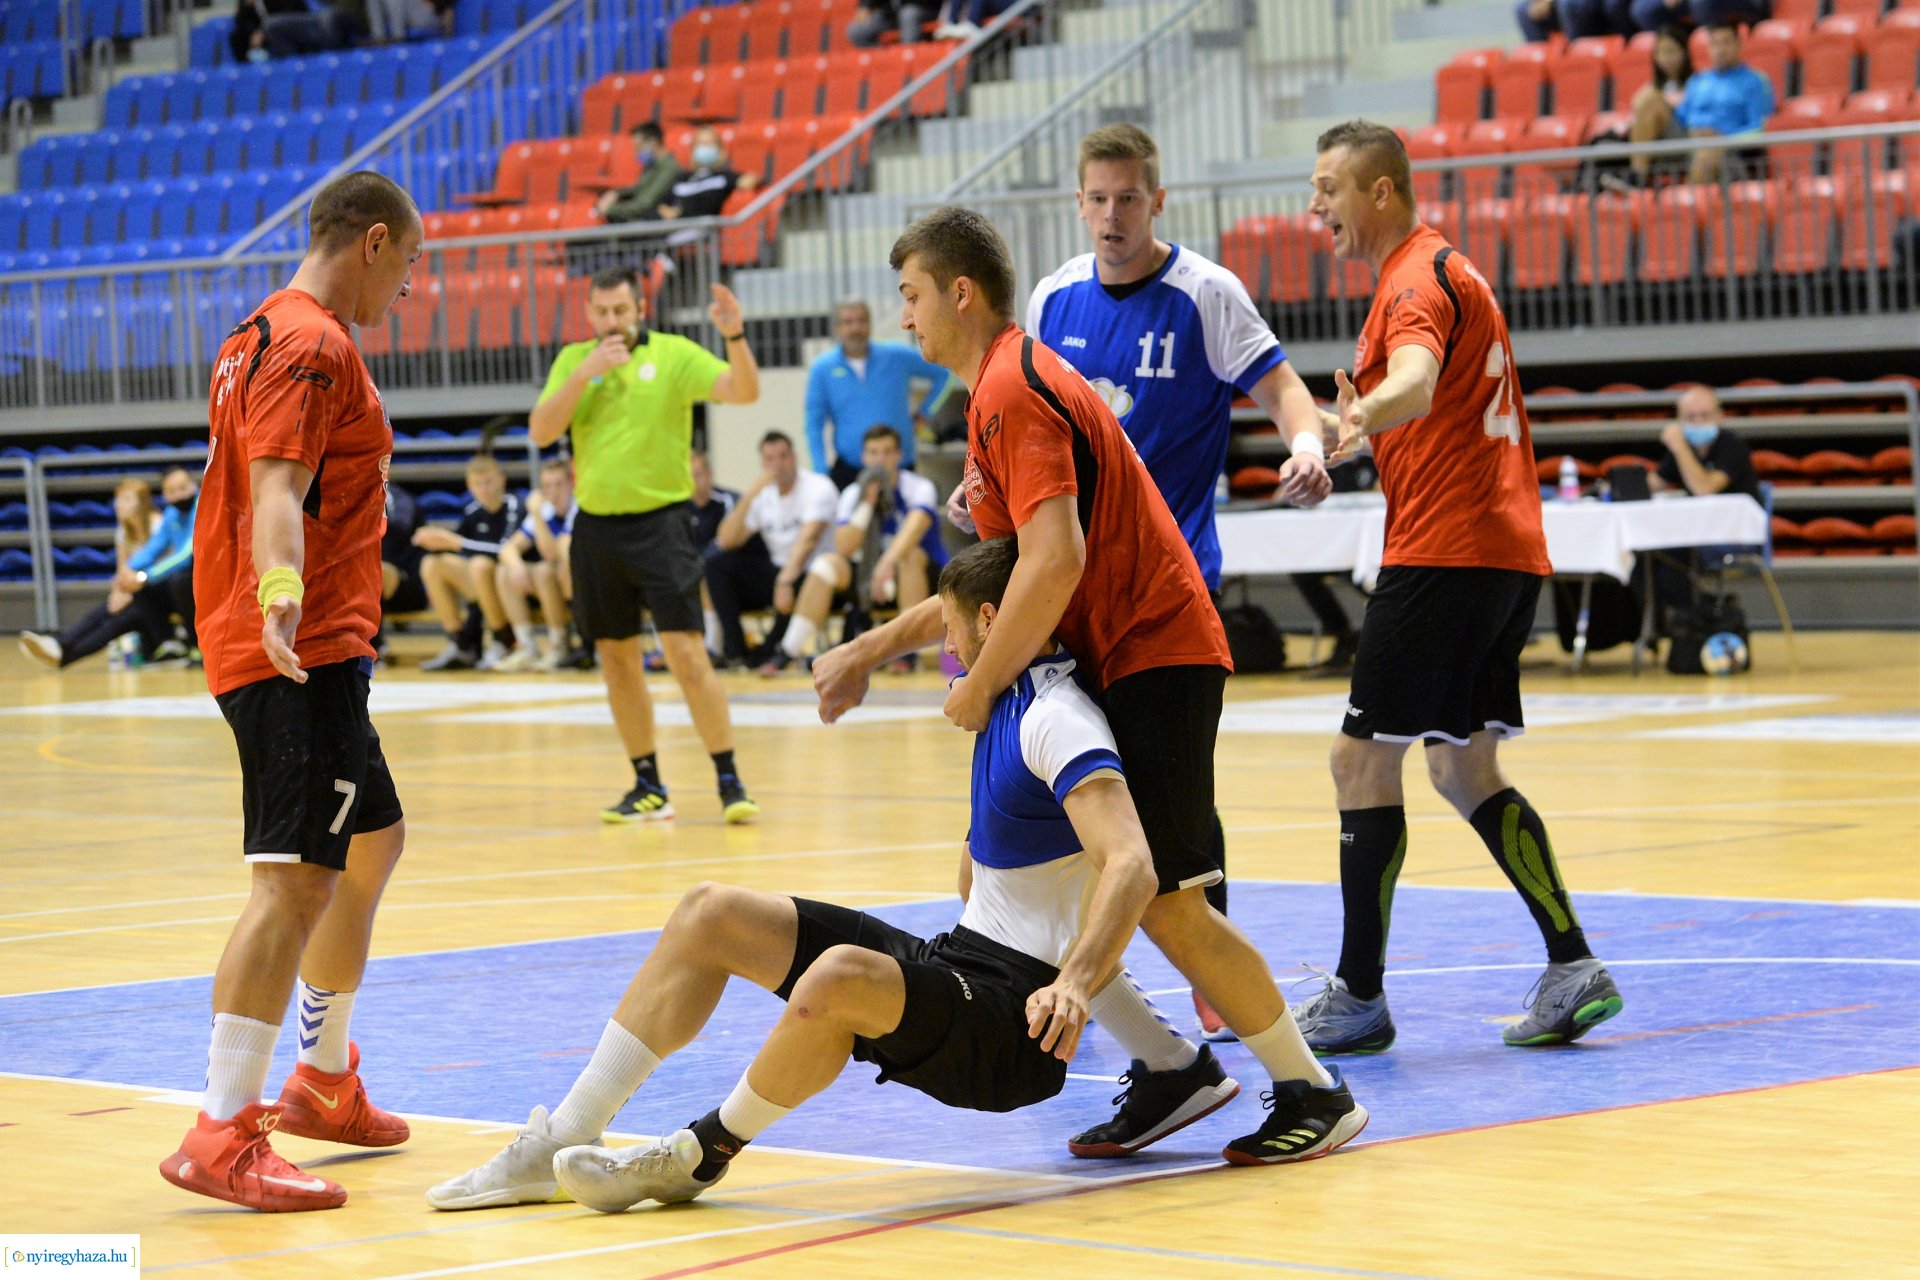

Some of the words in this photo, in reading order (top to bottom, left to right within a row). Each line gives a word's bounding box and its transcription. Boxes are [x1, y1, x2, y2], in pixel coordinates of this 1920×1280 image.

[1062, 336, 1087, 349] JAKO
[1135, 331, 1176, 378] 11
[329, 778, 357, 835] 7
[951, 971, 973, 1001] JAKO
